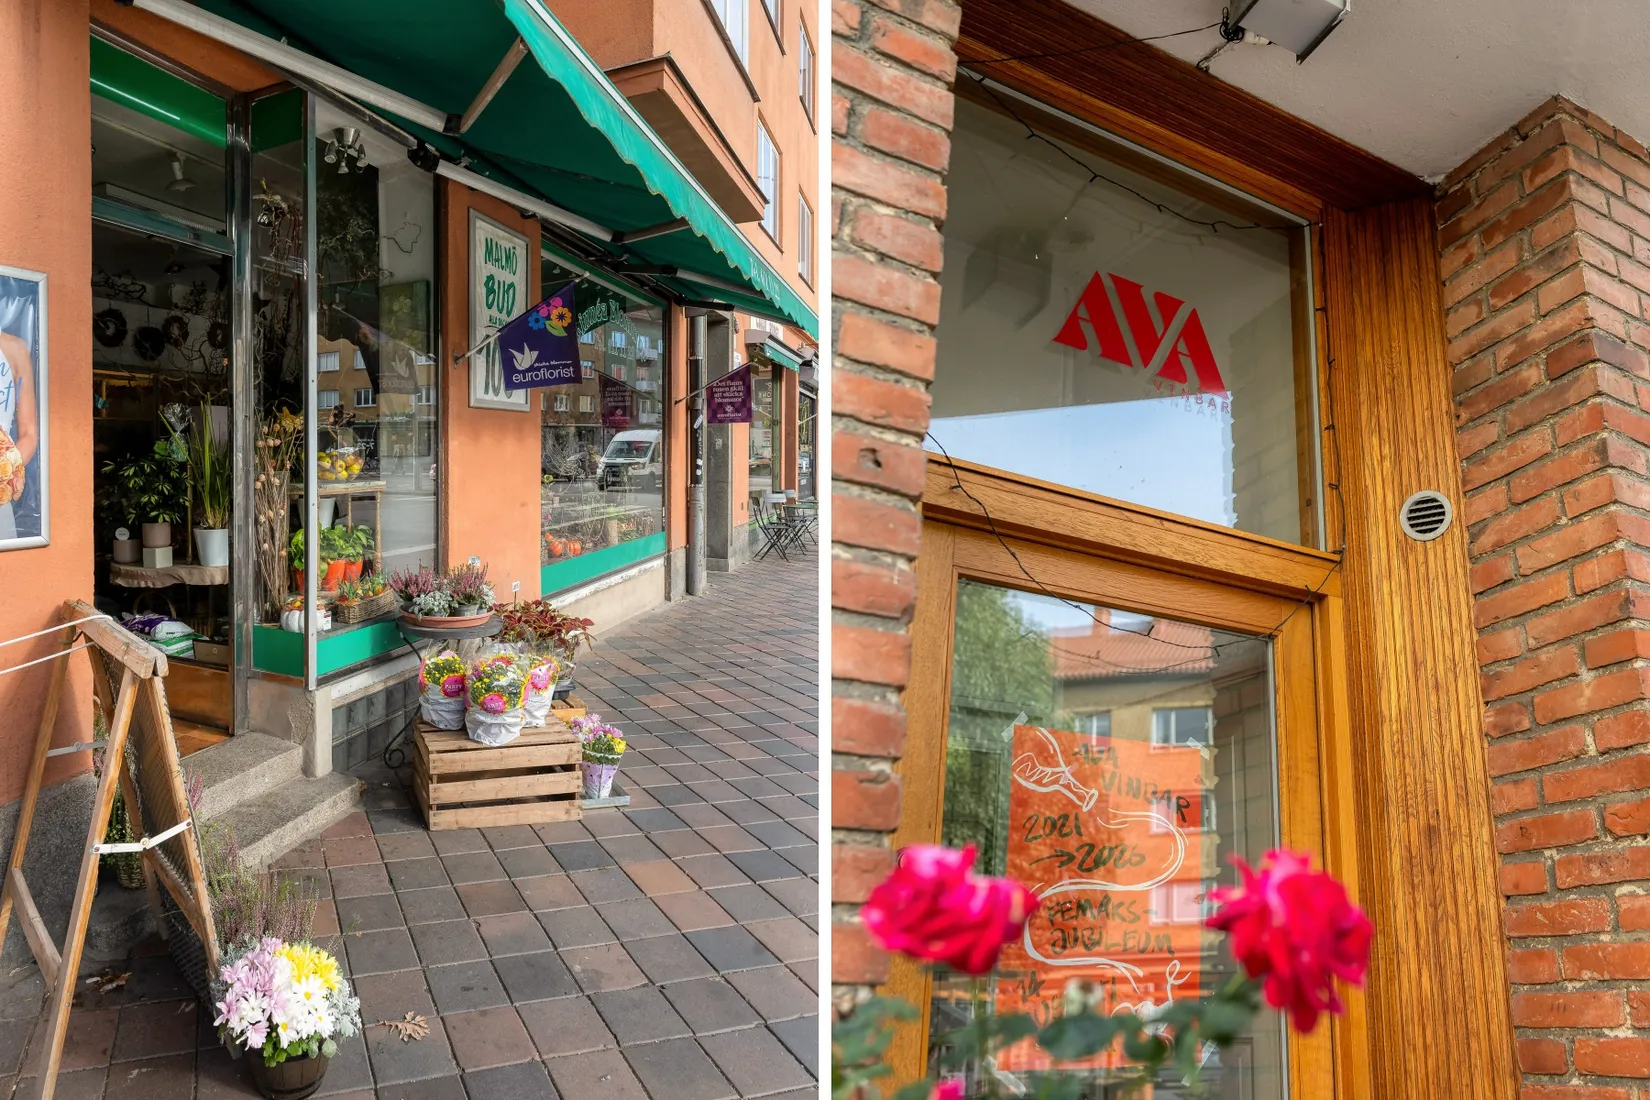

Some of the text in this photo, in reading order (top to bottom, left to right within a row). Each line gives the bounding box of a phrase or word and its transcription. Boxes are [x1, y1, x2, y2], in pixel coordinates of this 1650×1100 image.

[485, 237, 517, 276] MALMÖ
[484, 273, 516, 318] BUD
[1052, 270, 1229, 400] AVA
[476, 333, 514, 399] 10
[512, 366, 575, 383] euroflorist
[1153, 378, 1230, 414] VINBAR
[1101, 770, 1191, 823] VINBAR
[1022, 812, 1083, 843] 2021
[1074, 842, 1147, 873] 2026
[1050, 925, 1176, 956] JUBILEUM
